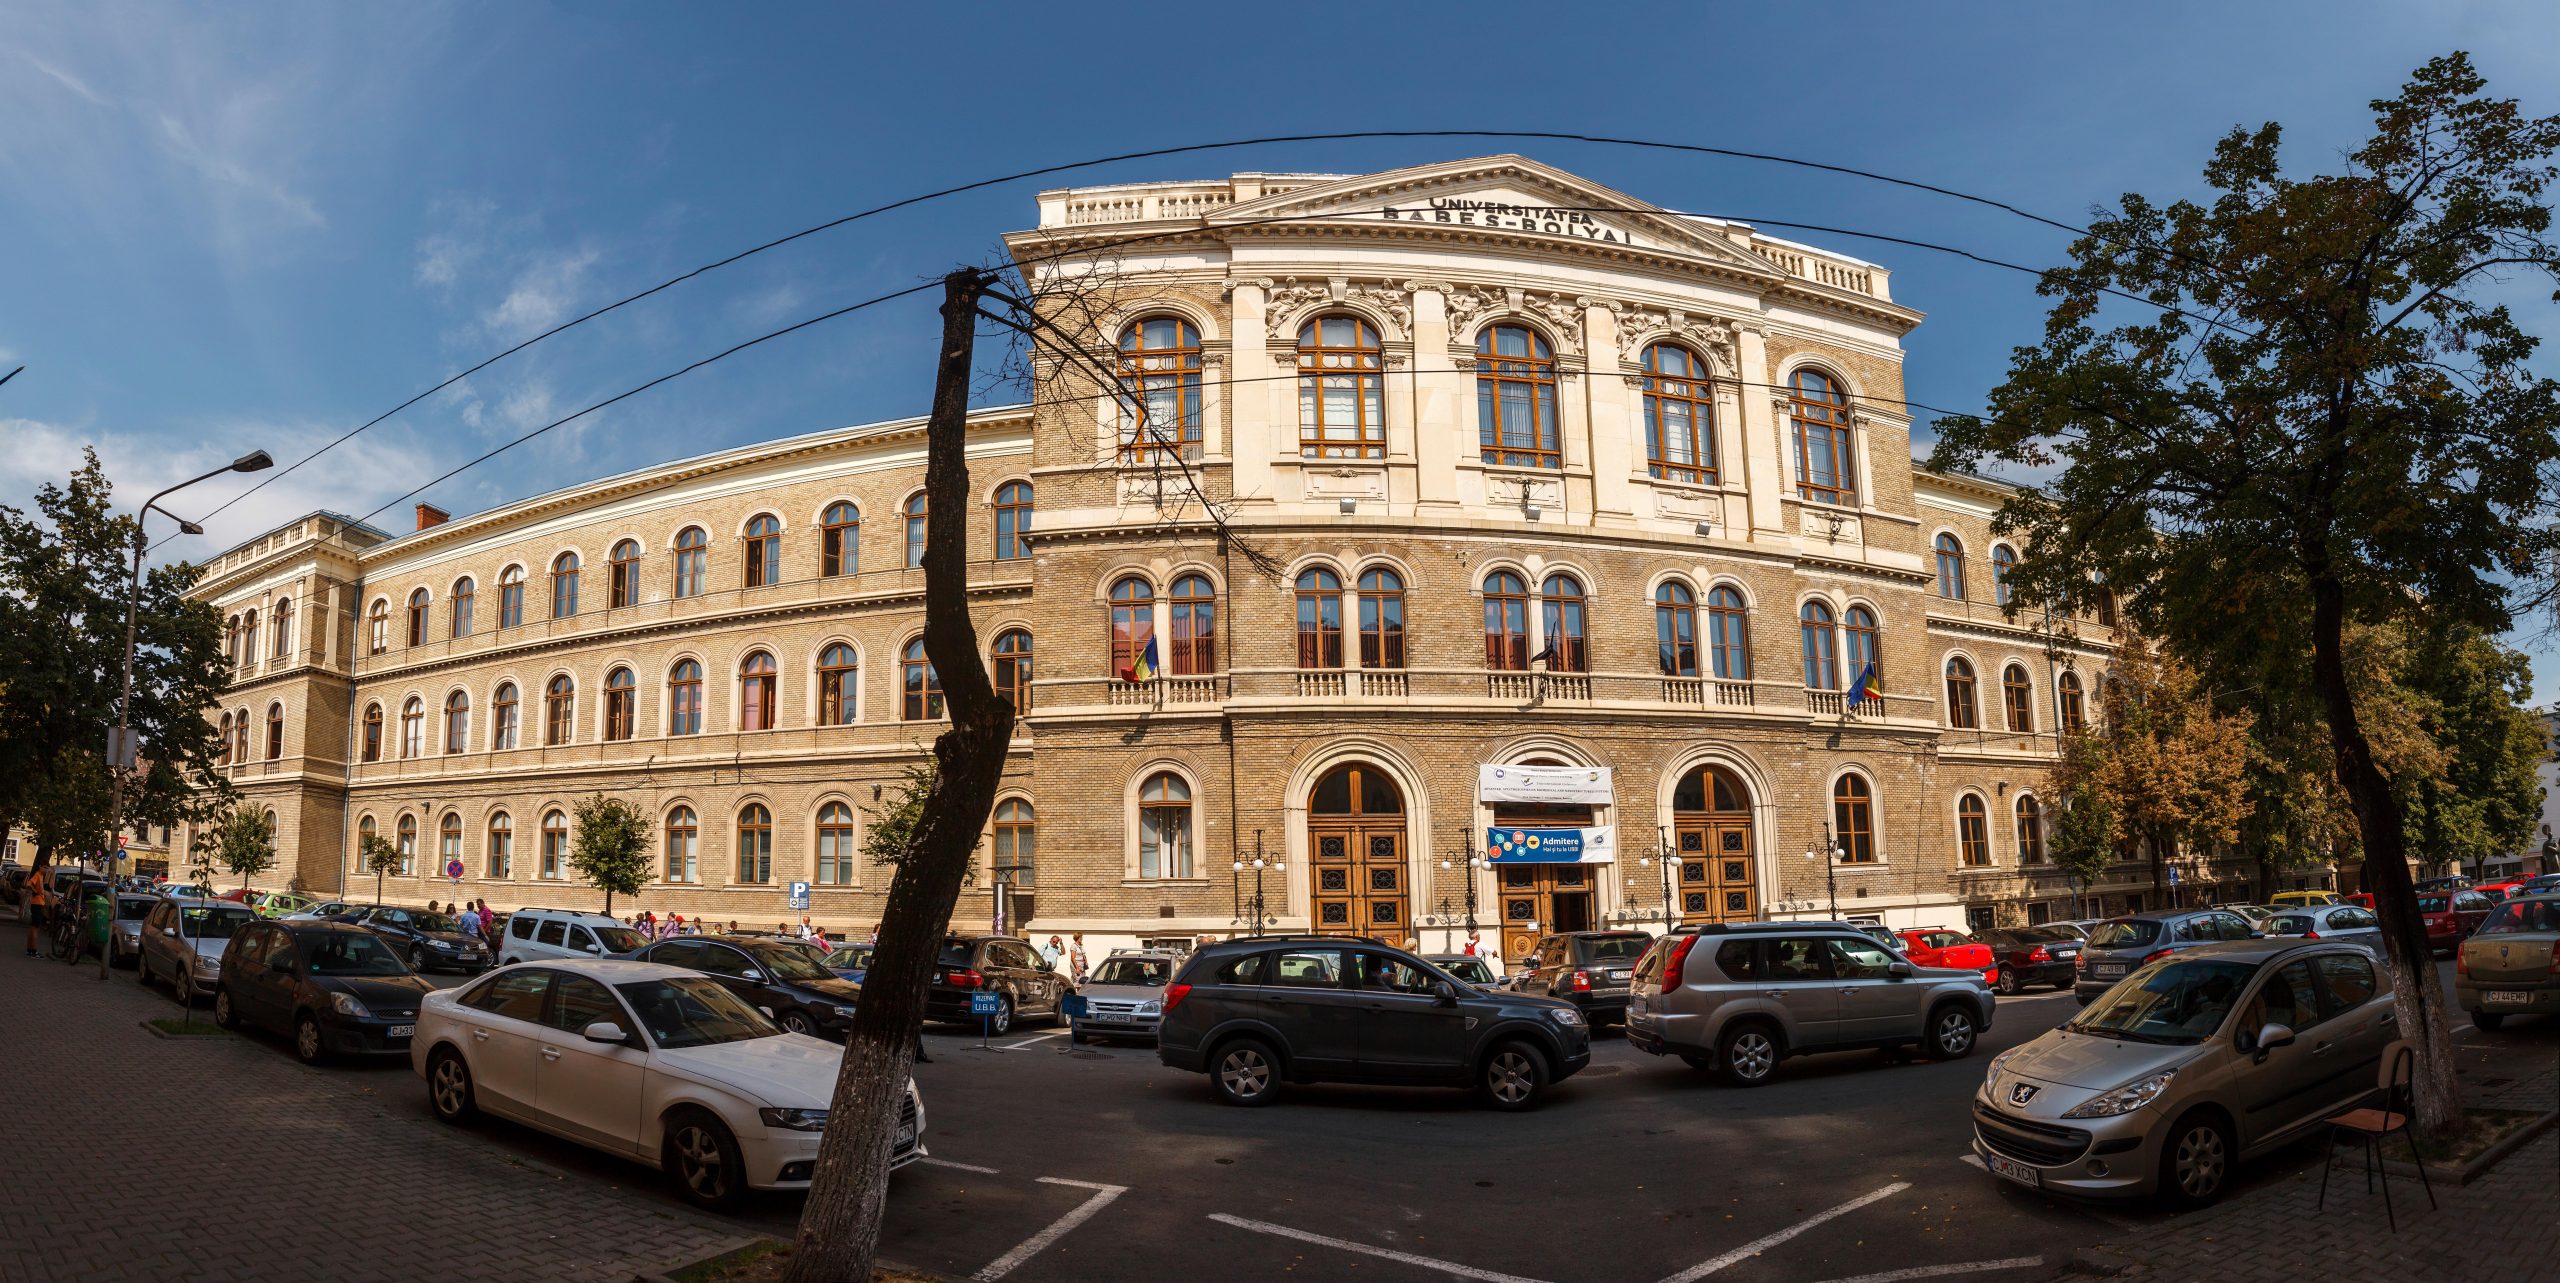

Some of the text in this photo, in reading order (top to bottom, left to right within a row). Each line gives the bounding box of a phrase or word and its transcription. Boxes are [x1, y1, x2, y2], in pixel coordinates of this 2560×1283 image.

[1429, 197, 1594, 226] UNIVERSITATEA
[1543, 837, 1579, 845] Admitere
[794, 882, 806, 898] P
[2491, 992, 2526, 1001] CJ 44 EMR
[392, 1026, 413, 1036] CJ 33
[1993, 1157, 2004, 1172] CJ
[2015, 1164, 2037, 1183] XCN
